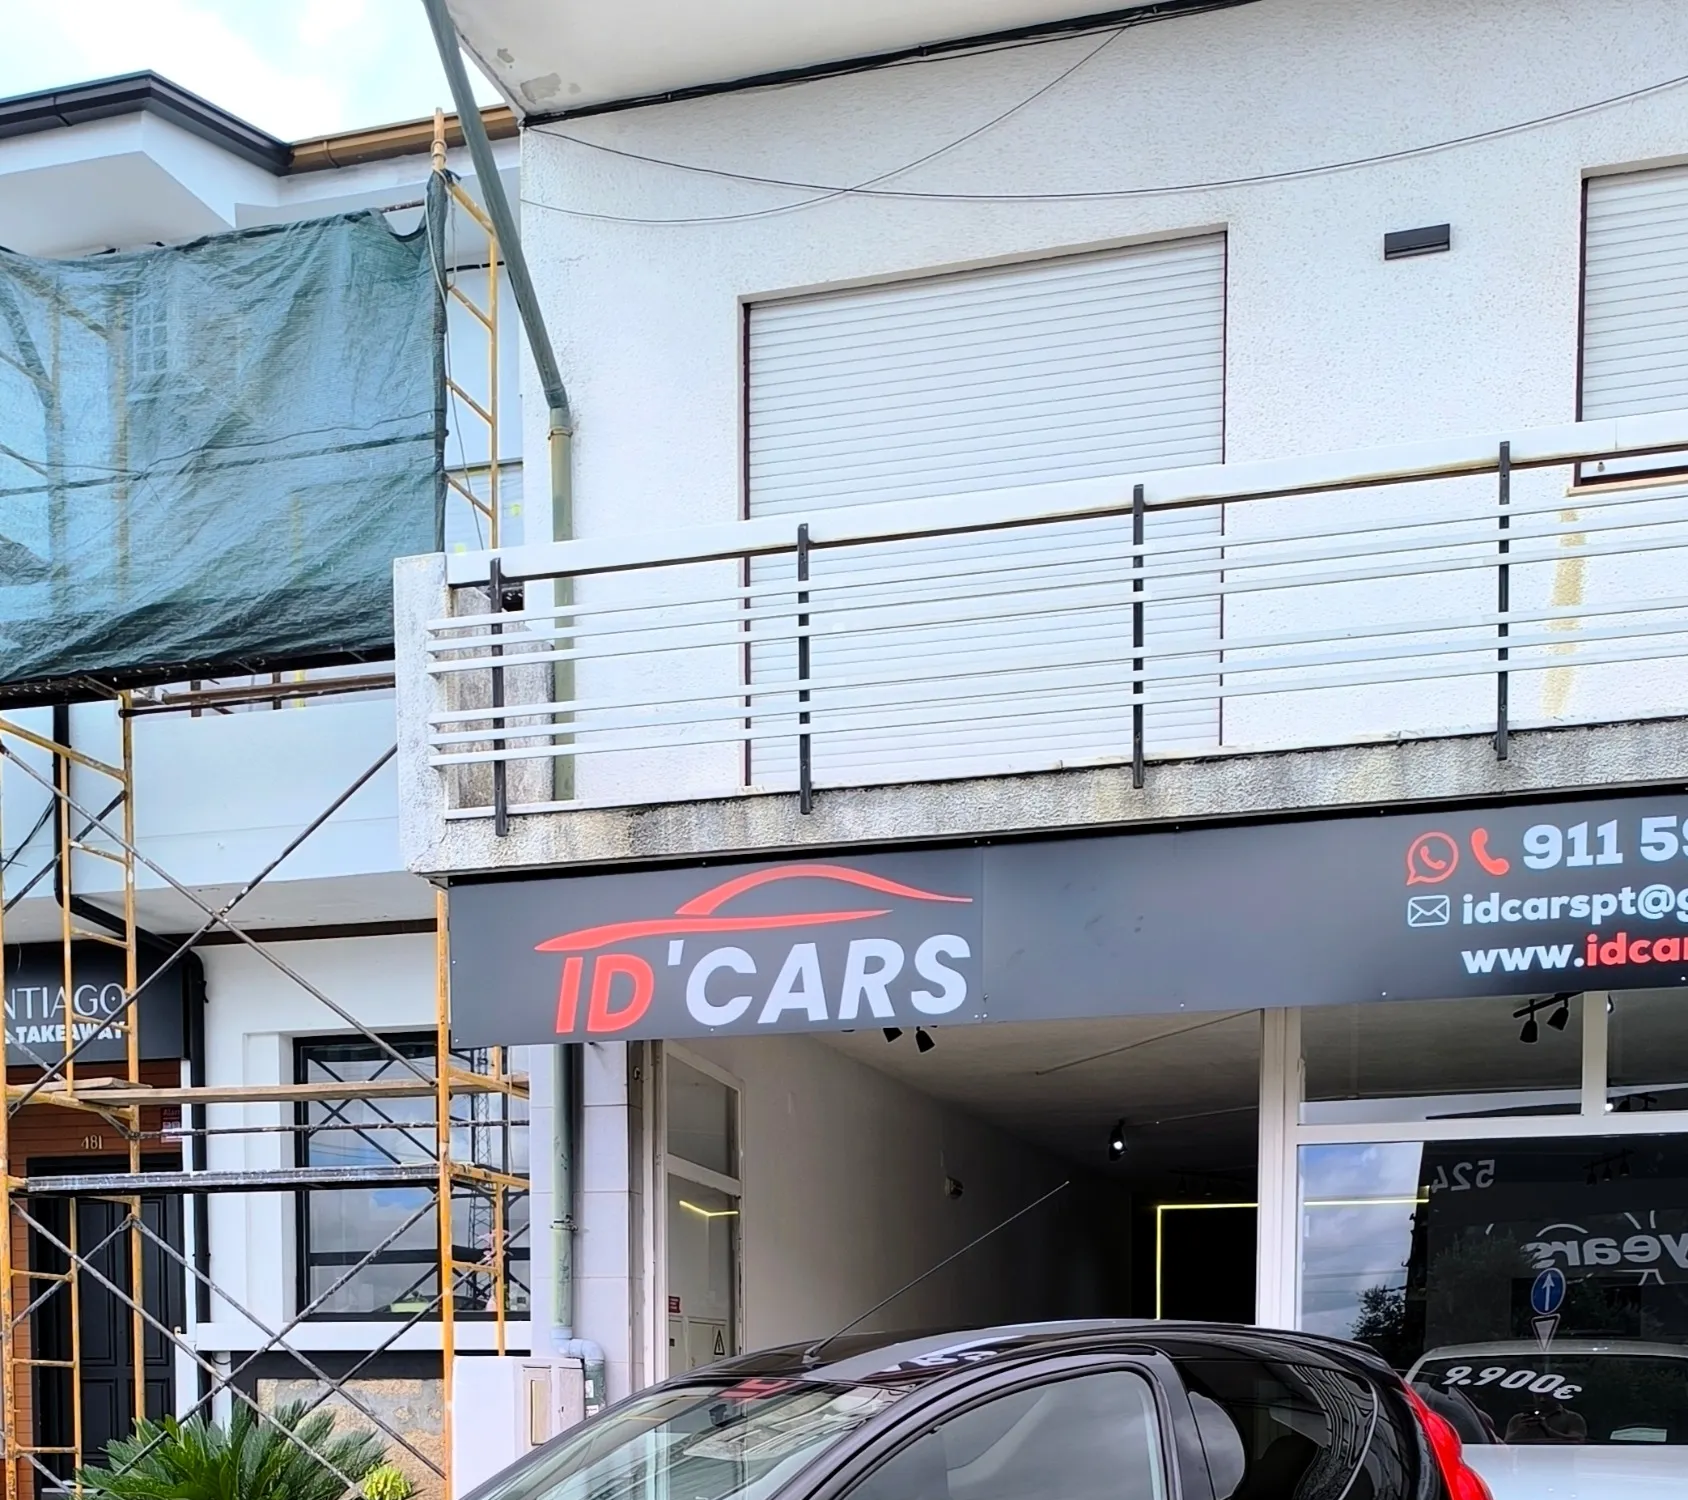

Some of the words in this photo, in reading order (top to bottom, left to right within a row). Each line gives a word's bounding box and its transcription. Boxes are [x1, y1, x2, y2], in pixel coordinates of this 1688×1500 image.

[1522, 819, 1624, 870] 911
[1639, 815, 1688, 862] 5
[1461, 932, 1688, 974] www.idca
[555, 933, 972, 1034] ID'CARS
[81, 1135, 103, 1150] 481
[1442, 1366, 1583, 1400] 9.900€
